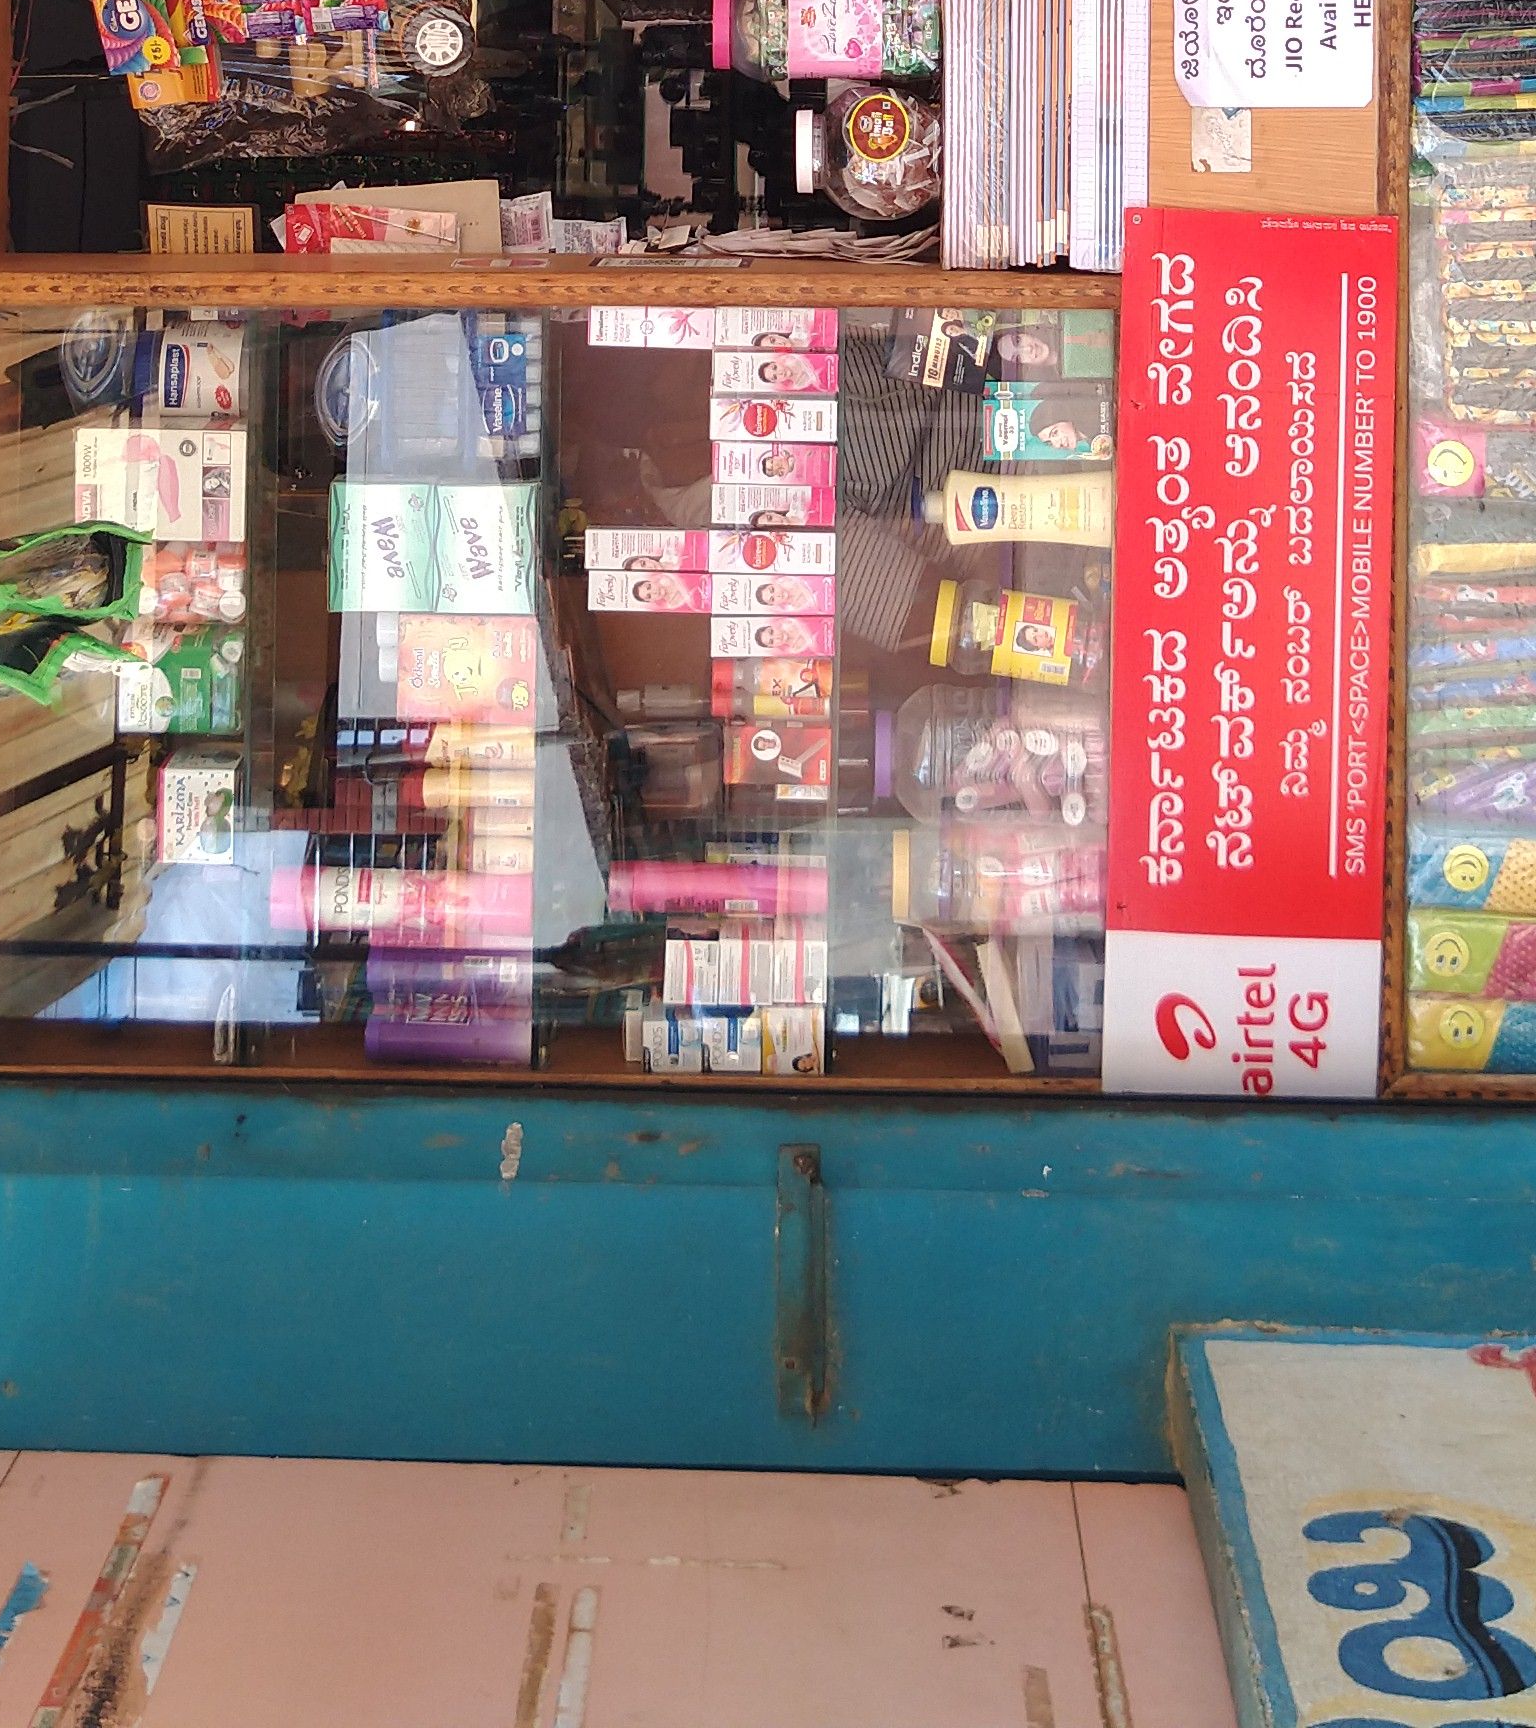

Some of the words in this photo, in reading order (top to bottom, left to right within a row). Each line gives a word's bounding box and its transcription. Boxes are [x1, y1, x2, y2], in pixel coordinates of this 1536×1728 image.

[1285, 36, 1305, 73] JIO
[1145, 251, 1198, 407] ವೇಗದ
[1355, 274, 1379, 342] 1900
[167, 346, 181, 406] Hansaplast
[1215, 274, 1265, 479] ಆನಂದಿಸಿ
[1354, 348, 1377, 386] TO
[491, 386, 505, 433] Vaseline
[82, 444, 92, 479] 1000W
[1281, 349, 1318, 567] ಬದಲಾಯಿಸದೆ
[978, 488, 990, 528] Vaseline
[1008, 503, 1020, 530] Deep
[1017, 492, 1028, 530] Restore
[1144, 433, 1216, 599] ಅತ್ಯಂತ
[370, 515, 406, 579] Wave
[459, 516, 496, 580] Wave
[1278, 584, 1314, 705] ನಂಬರ್
[1137, 627, 1187, 887] ಕರ್ನಾಟಕದ
[1277, 717, 1328, 798] ನಿಮ್ಮ
[170, 776, 186, 847] KARIZMA
[1344, 817, 1368, 876] SMS
[1230, 962, 1278, 1095] airtel
[1287, 990, 1330, 1070] 4G
